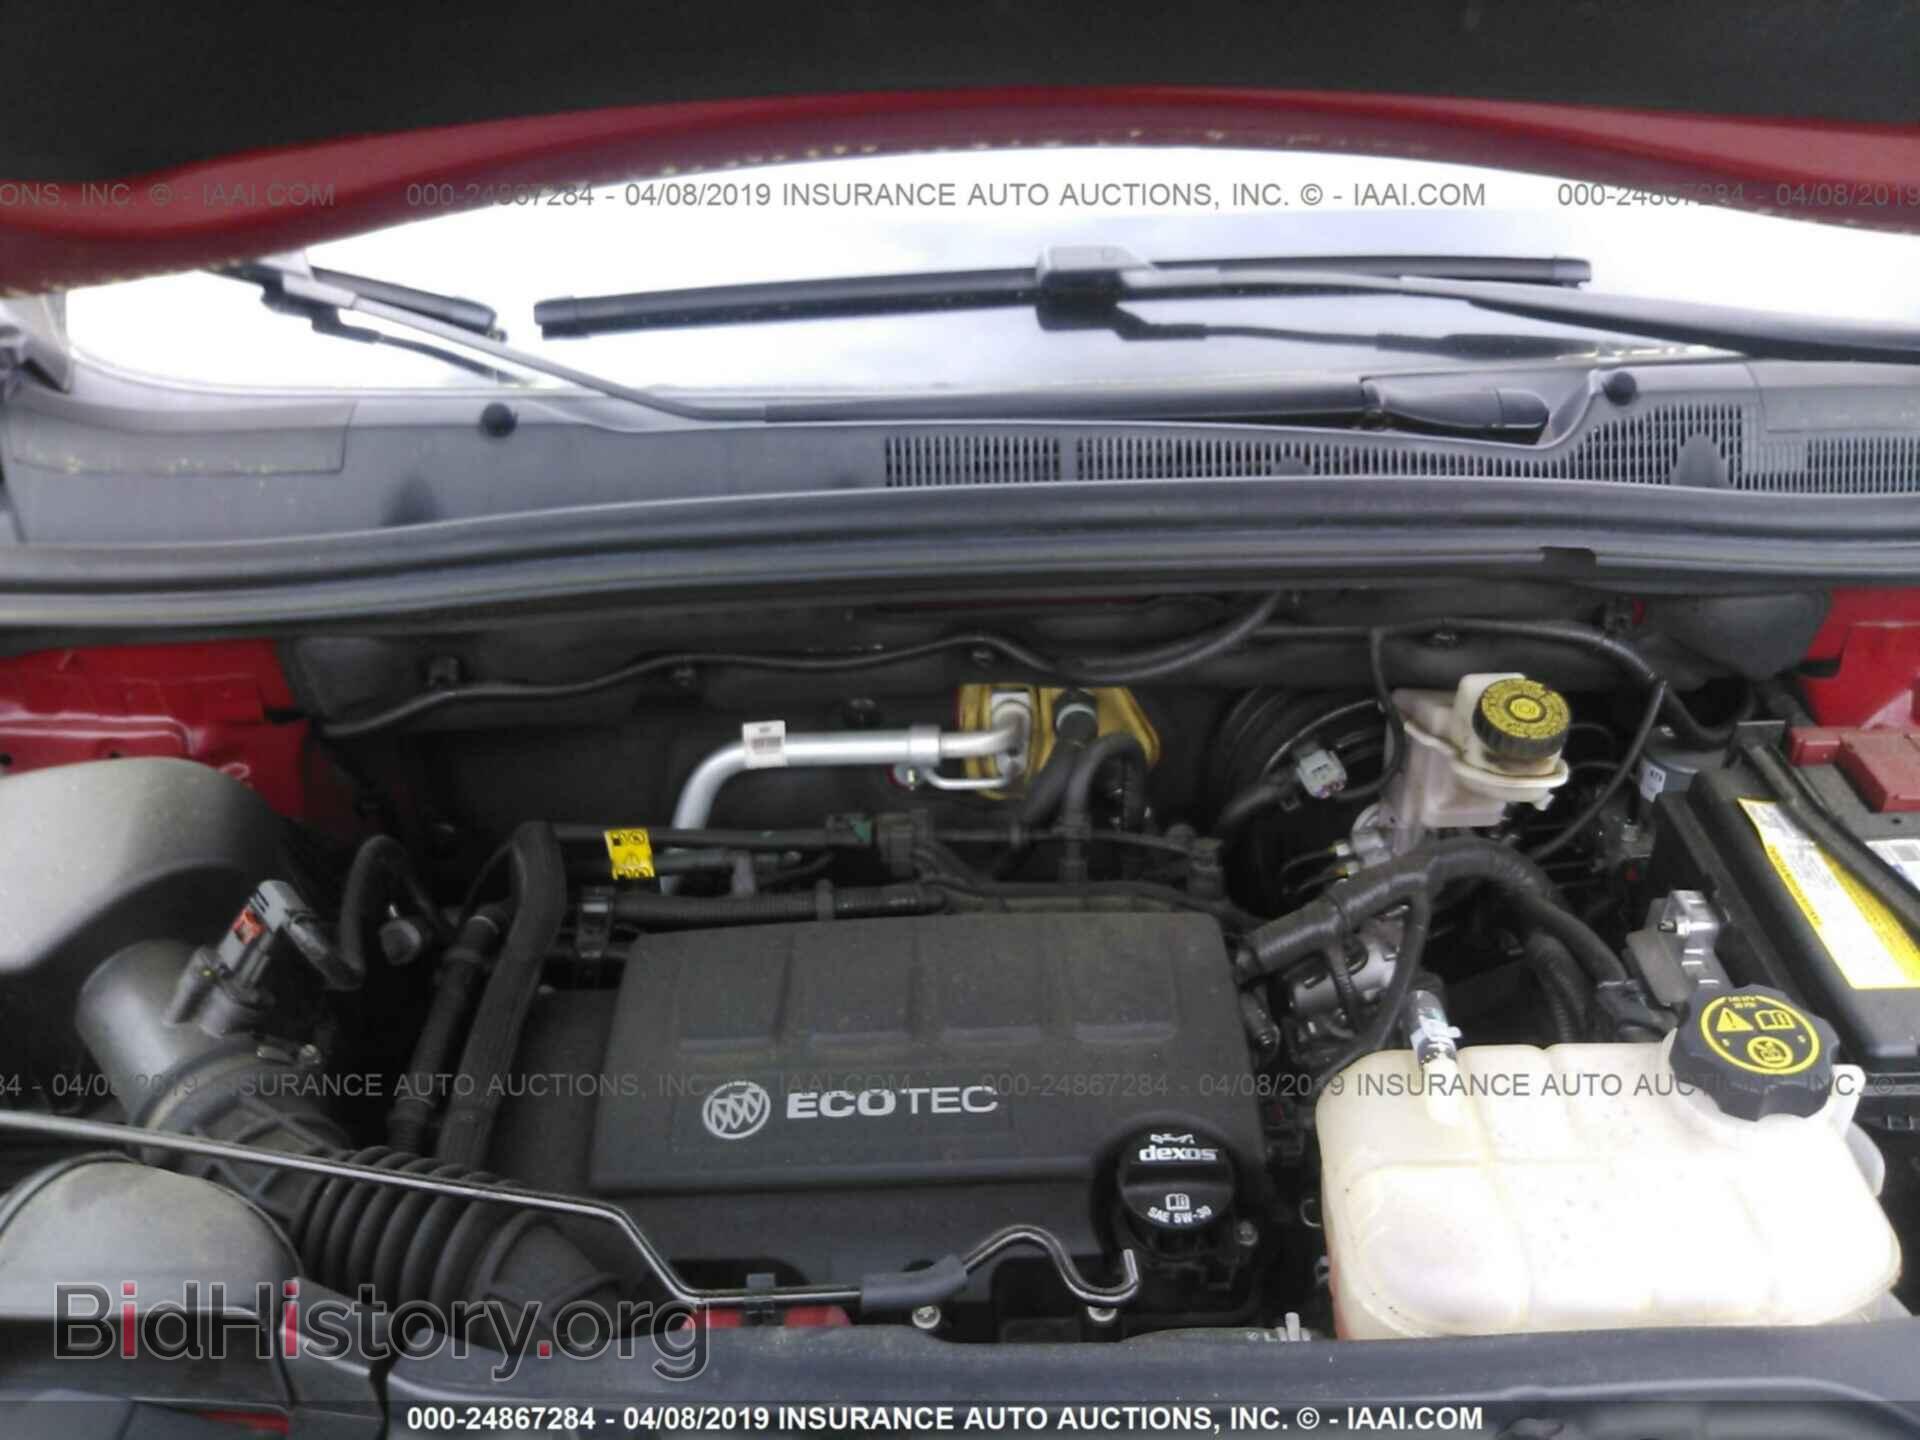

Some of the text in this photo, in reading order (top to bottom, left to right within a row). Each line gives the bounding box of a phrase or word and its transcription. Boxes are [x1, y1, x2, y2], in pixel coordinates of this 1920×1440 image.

[786, 1084, 999, 1120] ECOTEC
[1139, 1144, 1219, 1161] dexos
[1147, 1206, 1170, 1223] SAE
